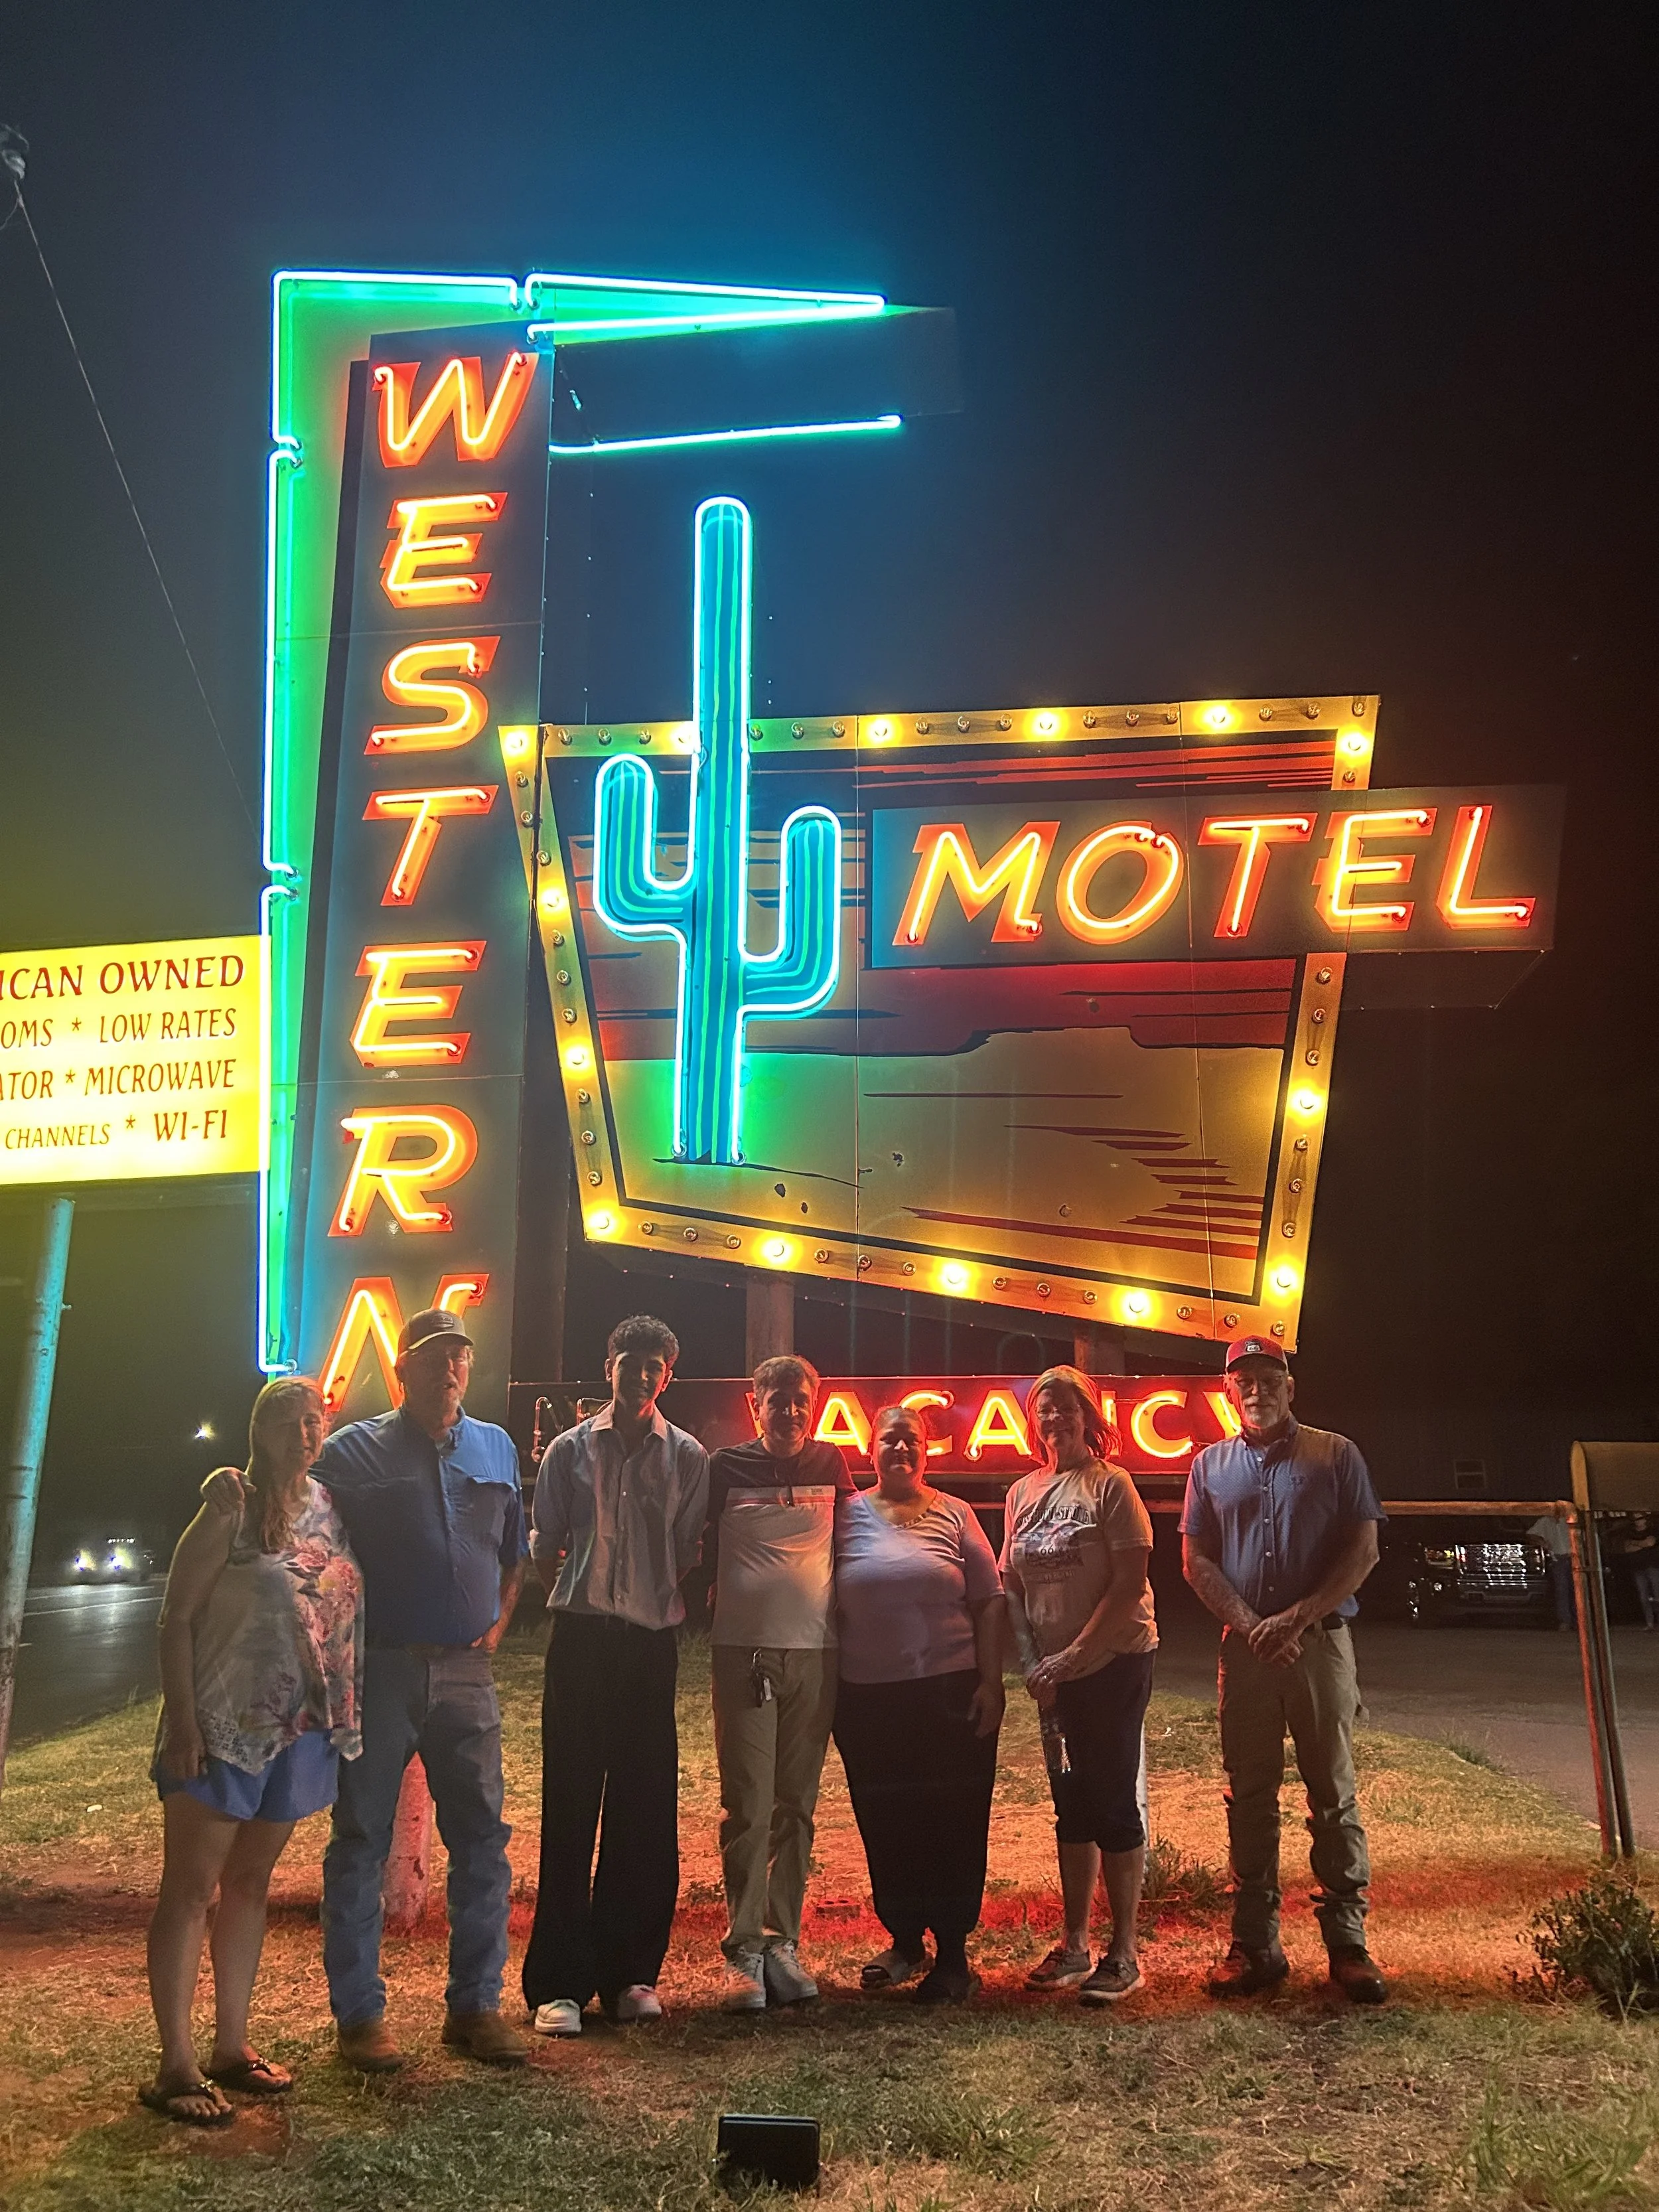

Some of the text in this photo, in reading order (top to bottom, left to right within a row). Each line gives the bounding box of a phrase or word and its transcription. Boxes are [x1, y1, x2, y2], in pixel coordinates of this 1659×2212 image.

[316, 350, 539, 1412] WESTERN
[892, 804, 1537, 946] MOTEL
[99, 954, 244, 994] OWNED
[0, 1007, 237, 1049] OMS LOW RATES
[0, 1059, 237, 1101] TOR MICROWAVE
[5, 1109, 228, 1149] CHANNELS WI-FI
[1040, 1544, 1054, 1556] 66
